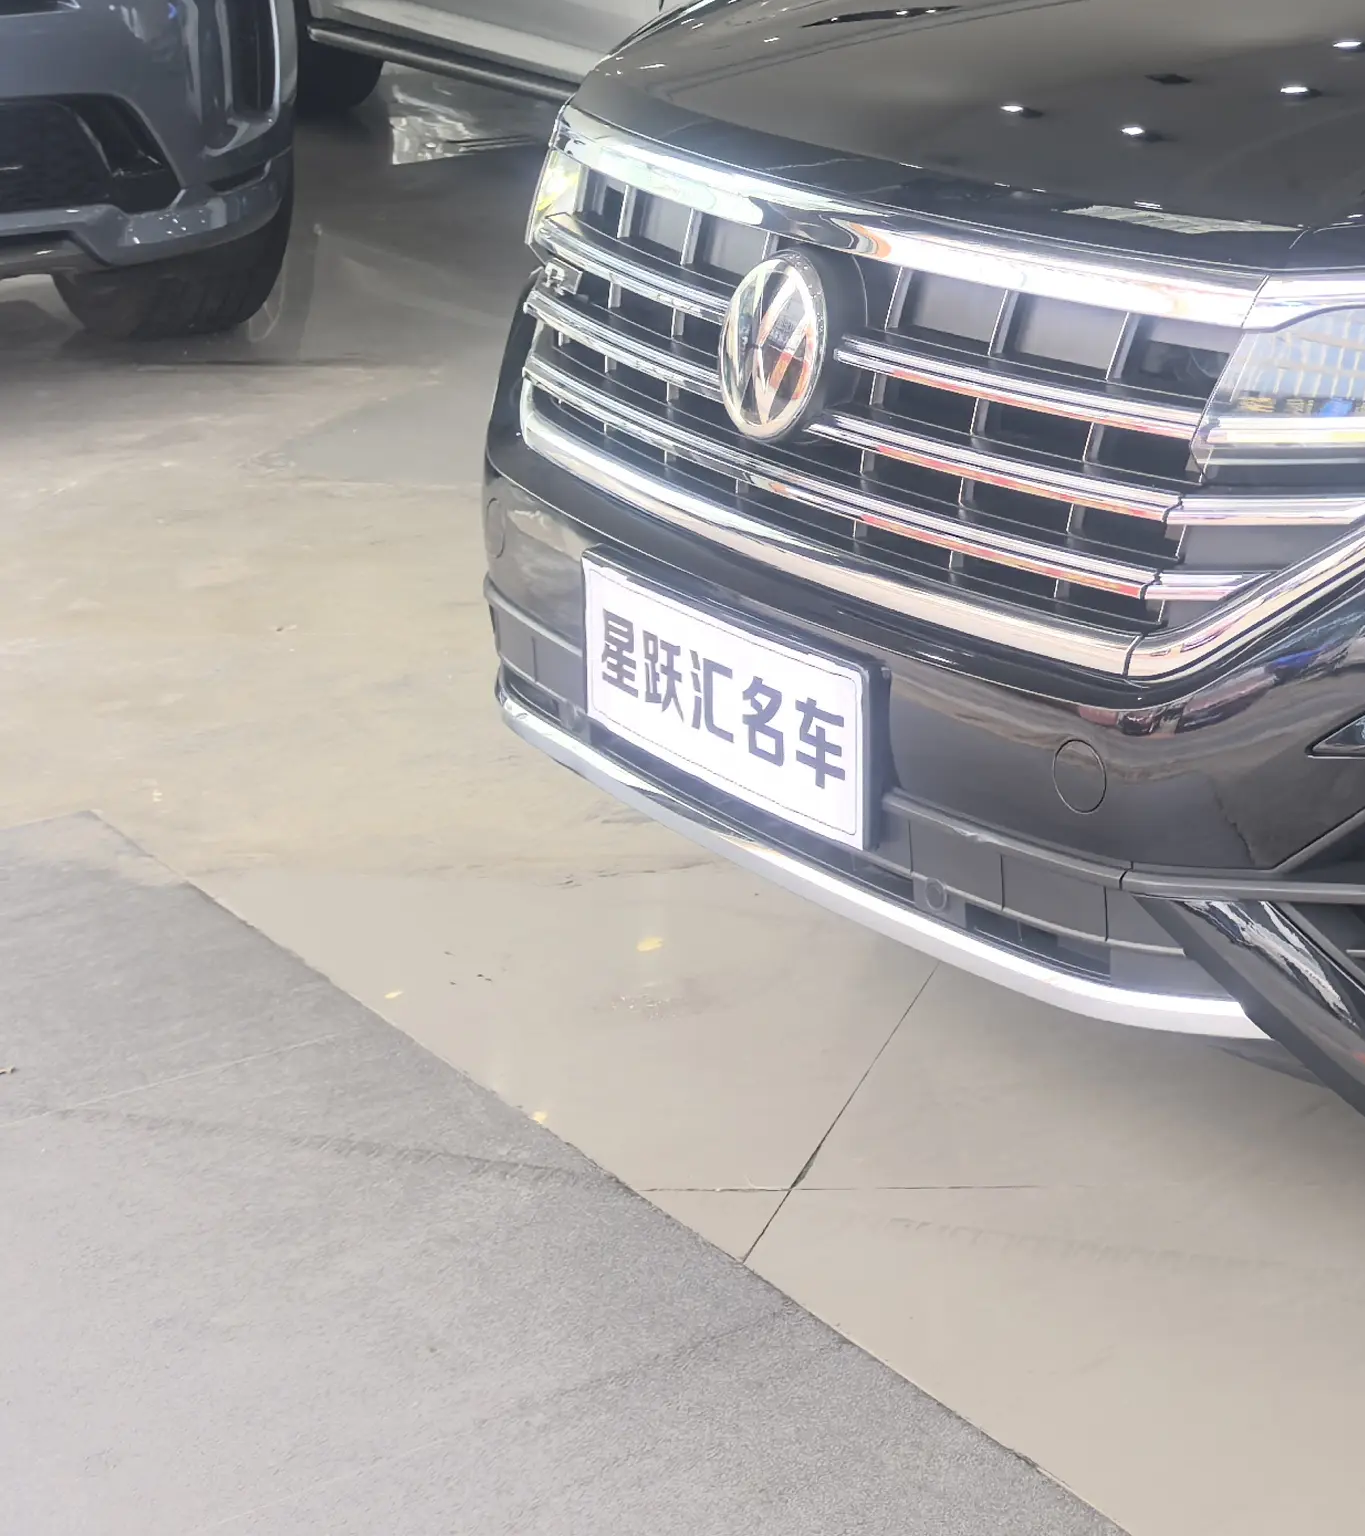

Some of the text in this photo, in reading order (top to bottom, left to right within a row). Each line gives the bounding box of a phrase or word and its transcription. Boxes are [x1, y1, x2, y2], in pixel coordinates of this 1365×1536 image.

[601, 607, 846, 790] 星跃汇名车
